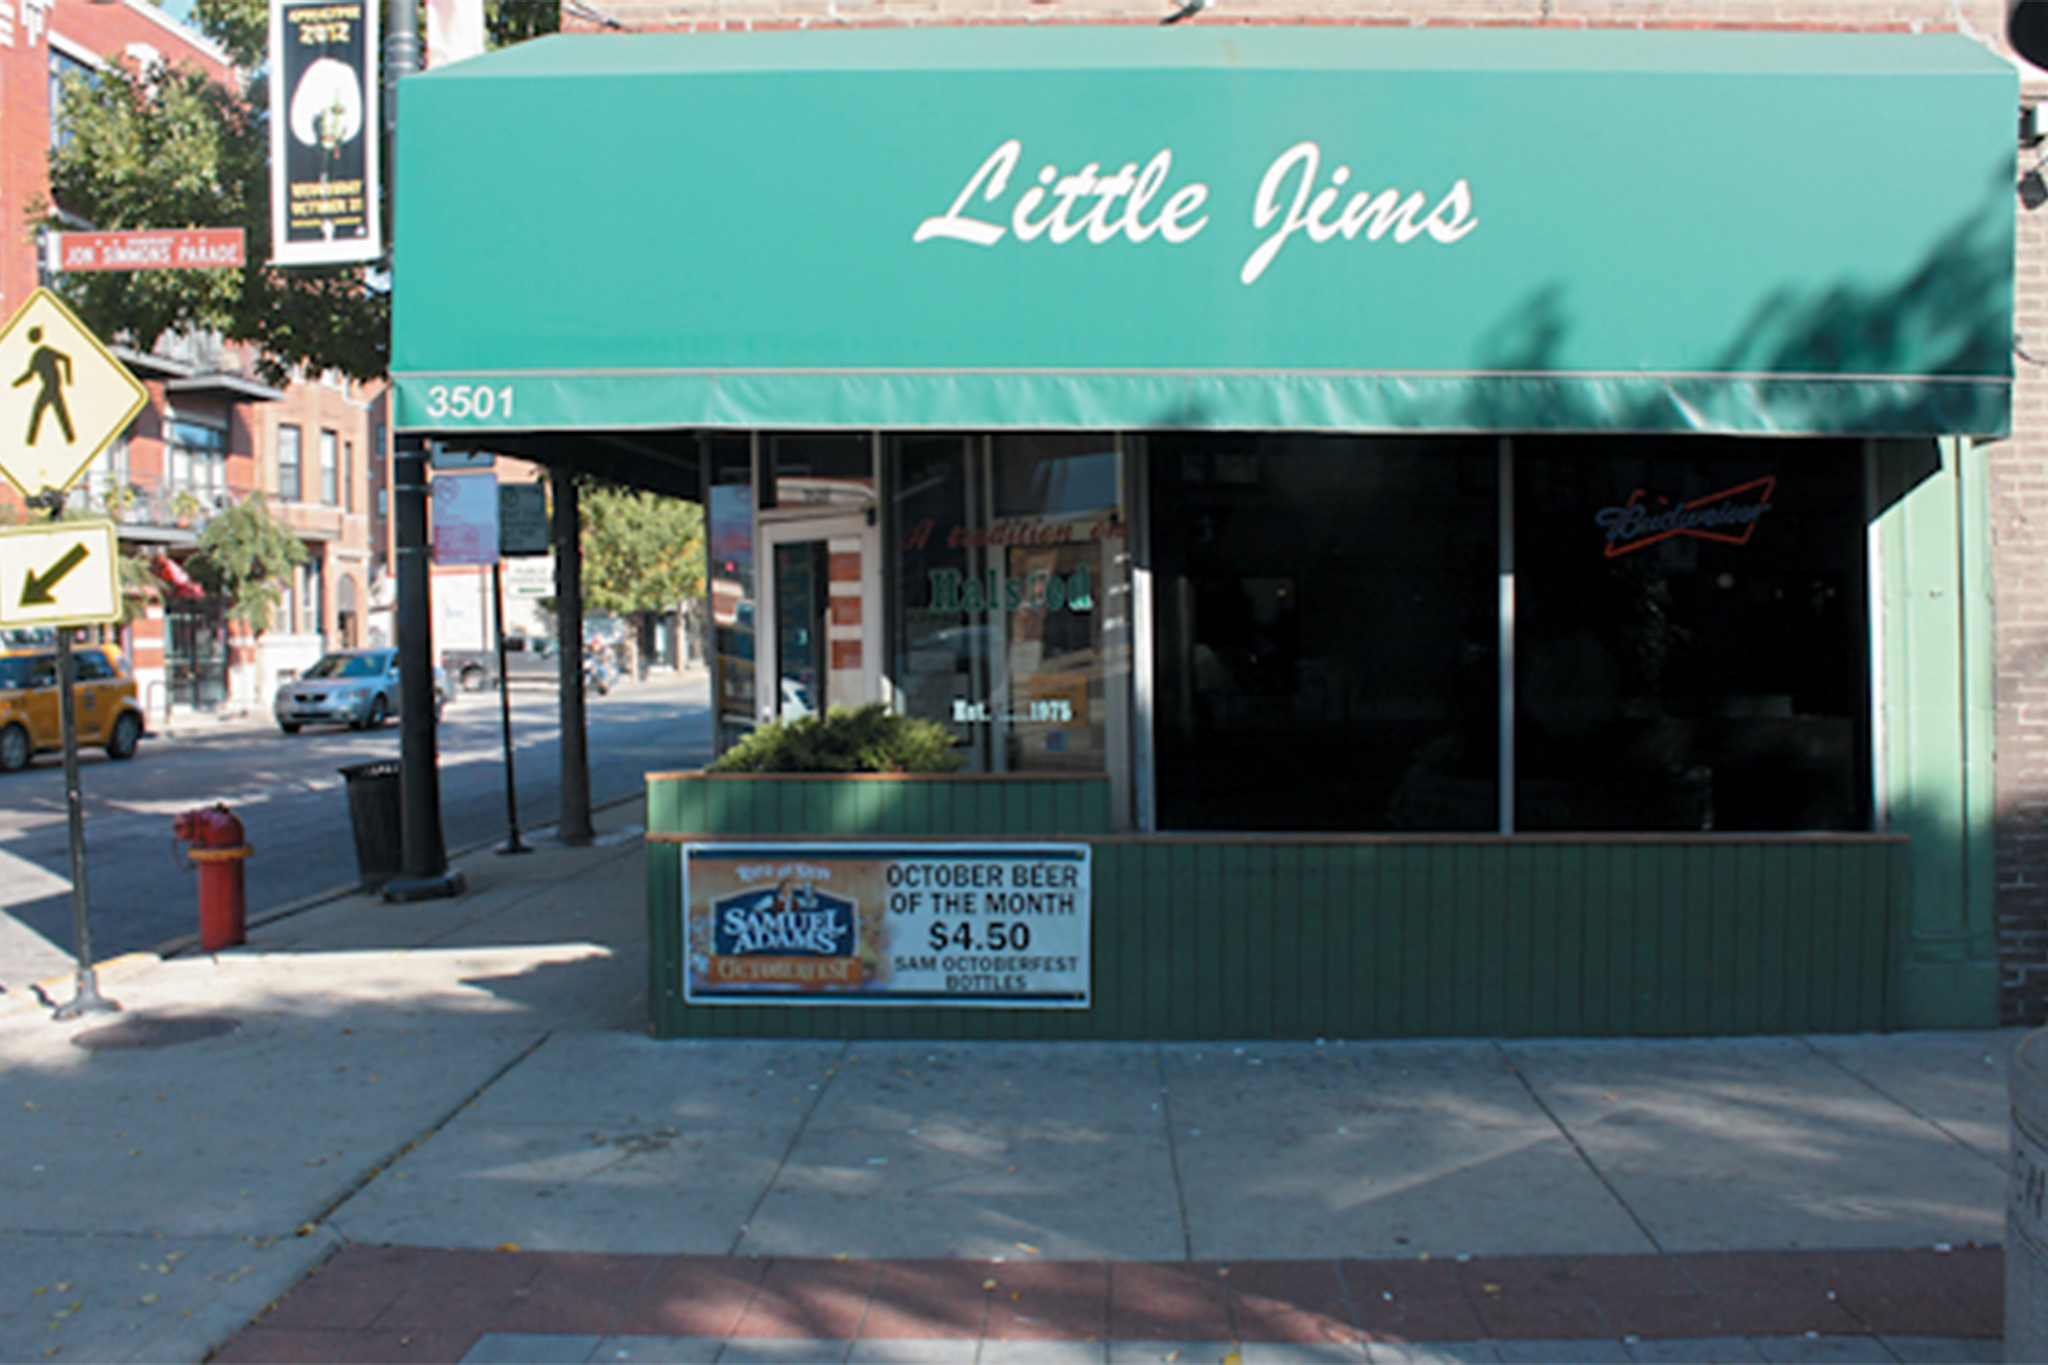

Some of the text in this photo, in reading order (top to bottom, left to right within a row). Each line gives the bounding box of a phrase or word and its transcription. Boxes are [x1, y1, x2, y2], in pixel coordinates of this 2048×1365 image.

[298, 21, 351, 45] 2012
[913, 138, 1479, 285] Little Jims
[178, 242, 239, 263] PARADE
[426, 384, 513, 419] 3501
[886, 863, 1079, 888] OCTOBER BEER
[890, 892, 1076, 915] OF THE MONTH
[723, 907, 848, 936] SAMUEL
[732, 930, 838, 955] ADAMS
[929, 921, 1031, 951] $4.50
[895, 955, 1079, 972] SAM OCTOBERFEST
[945, 974, 1027, 991] BOTTLES
